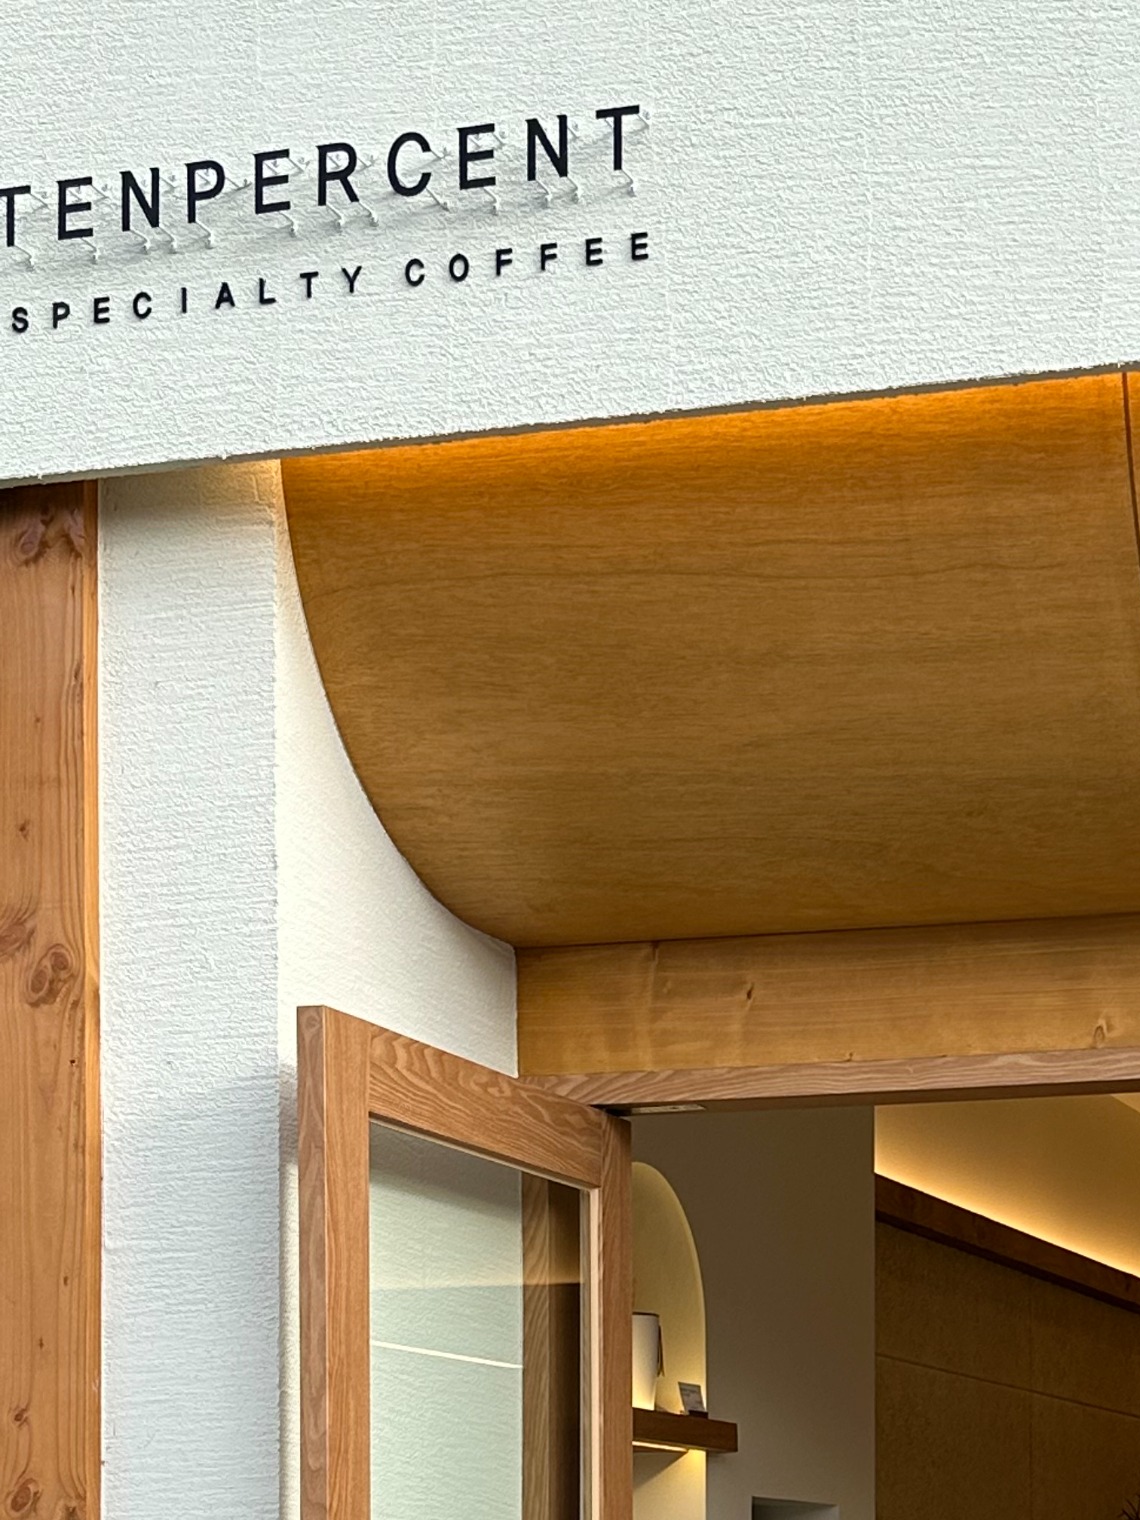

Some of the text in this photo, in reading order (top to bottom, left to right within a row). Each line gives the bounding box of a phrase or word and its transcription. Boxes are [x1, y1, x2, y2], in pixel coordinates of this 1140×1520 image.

[0, 105, 640, 247] TENPERCENT
[11, 231, 649, 333] SPECIALTY COFFEE
